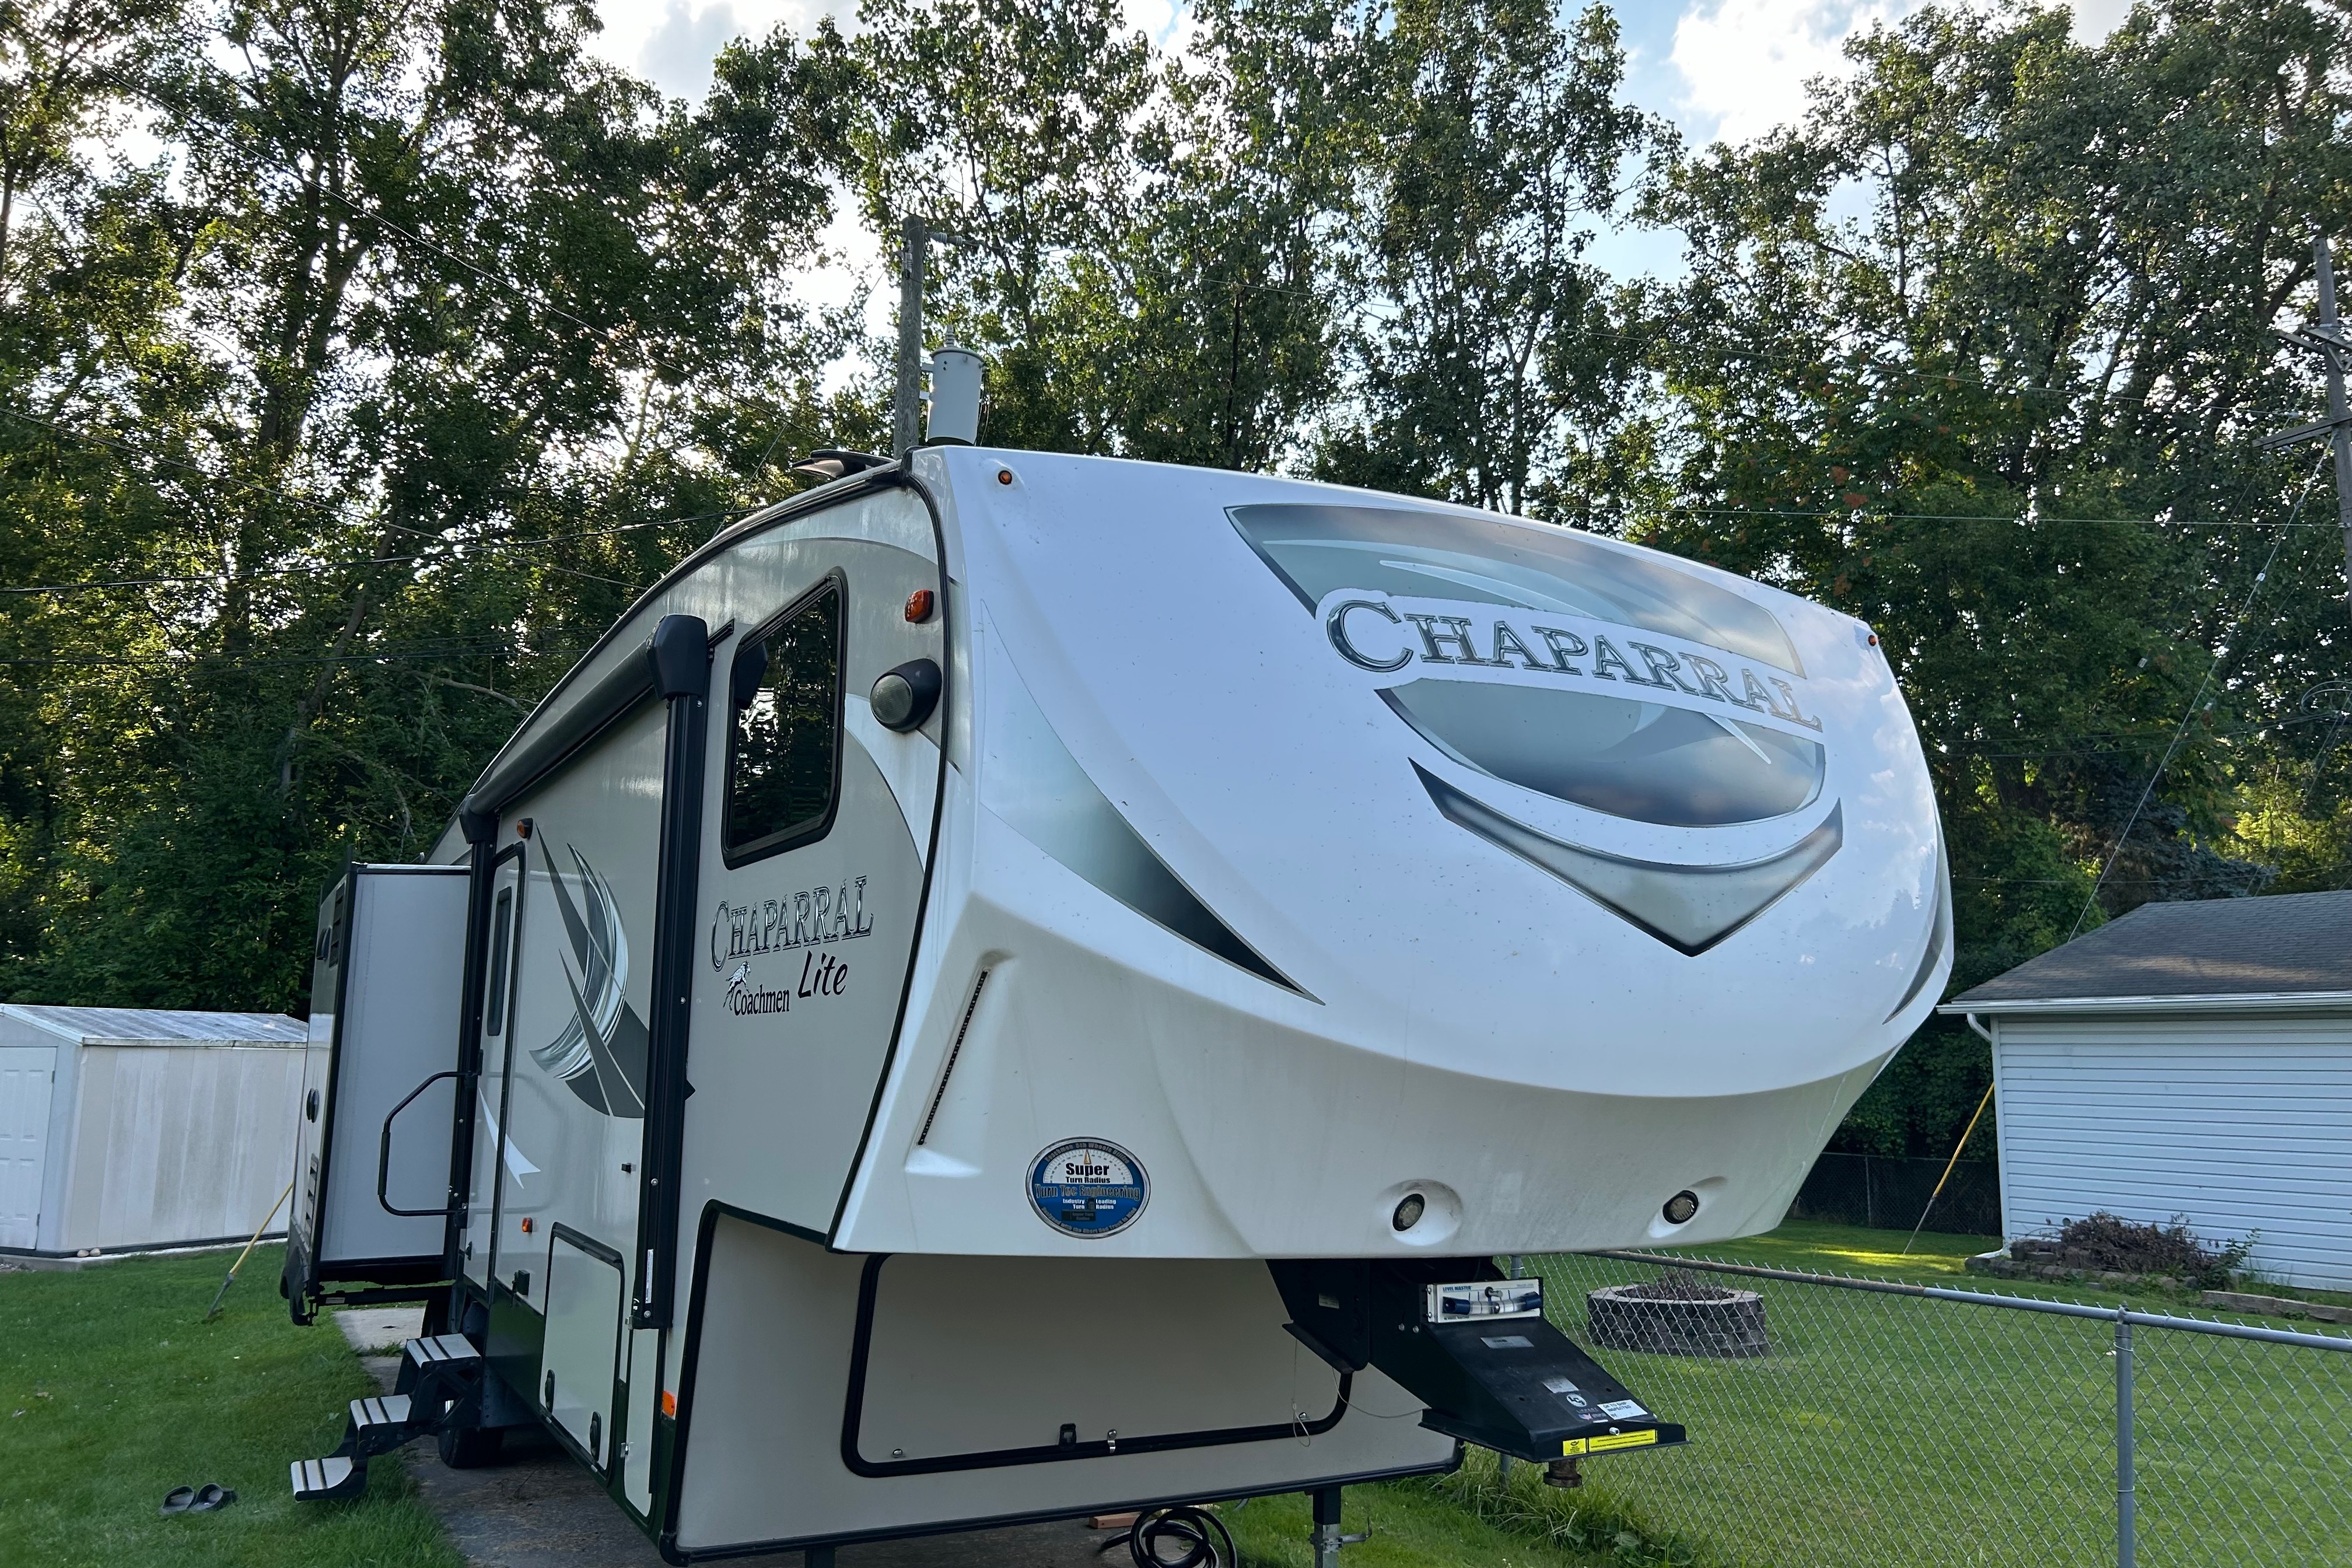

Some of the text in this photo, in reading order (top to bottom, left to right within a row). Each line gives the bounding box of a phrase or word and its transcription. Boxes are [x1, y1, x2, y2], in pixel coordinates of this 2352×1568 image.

[1326, 598, 1824, 733] CHAPARRAL
[710, 875, 874, 972] CHAPARRAL
[797, 950, 848, 999] Lite
[733, 984, 790, 1016] Coachmen
[1065, 1163, 1110, 1177] Super
[1034, 1184, 1058, 1199] Turn
[1079, 1185, 1141, 1202] Engineering
